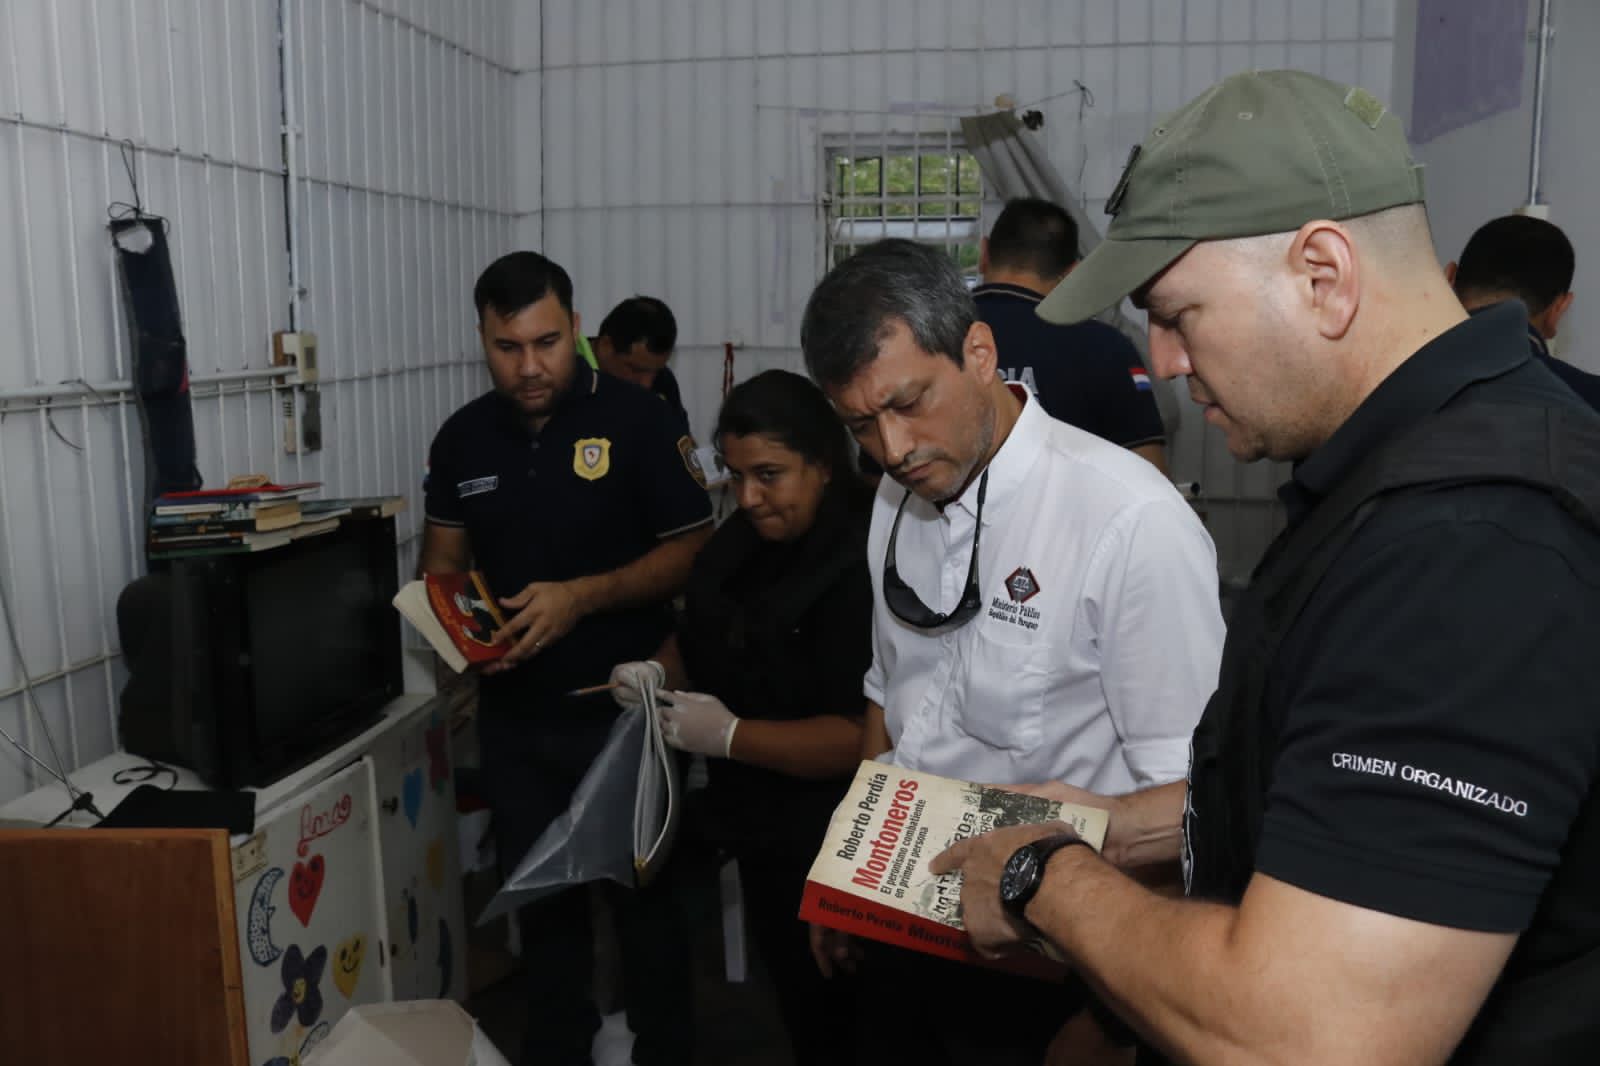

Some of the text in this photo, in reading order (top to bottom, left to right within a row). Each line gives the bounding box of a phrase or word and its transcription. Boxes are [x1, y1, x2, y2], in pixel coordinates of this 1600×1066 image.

[992, 596, 1018, 614] Ministerio
[1009, 613, 1017, 624] del
[1018, 616, 1039, 631] Paraguay
[836, 773, 888, 861] Roberto Perdía
[1332, 752, 1529, 817] CRIMEN ORGANIZADO
[851, 779, 919, 891] Montoneros
[880, 799, 926, 895] El peronismo combatiente
[894, 826, 929, 899] en primera persona
[817, 897, 864, 921] Roberto
